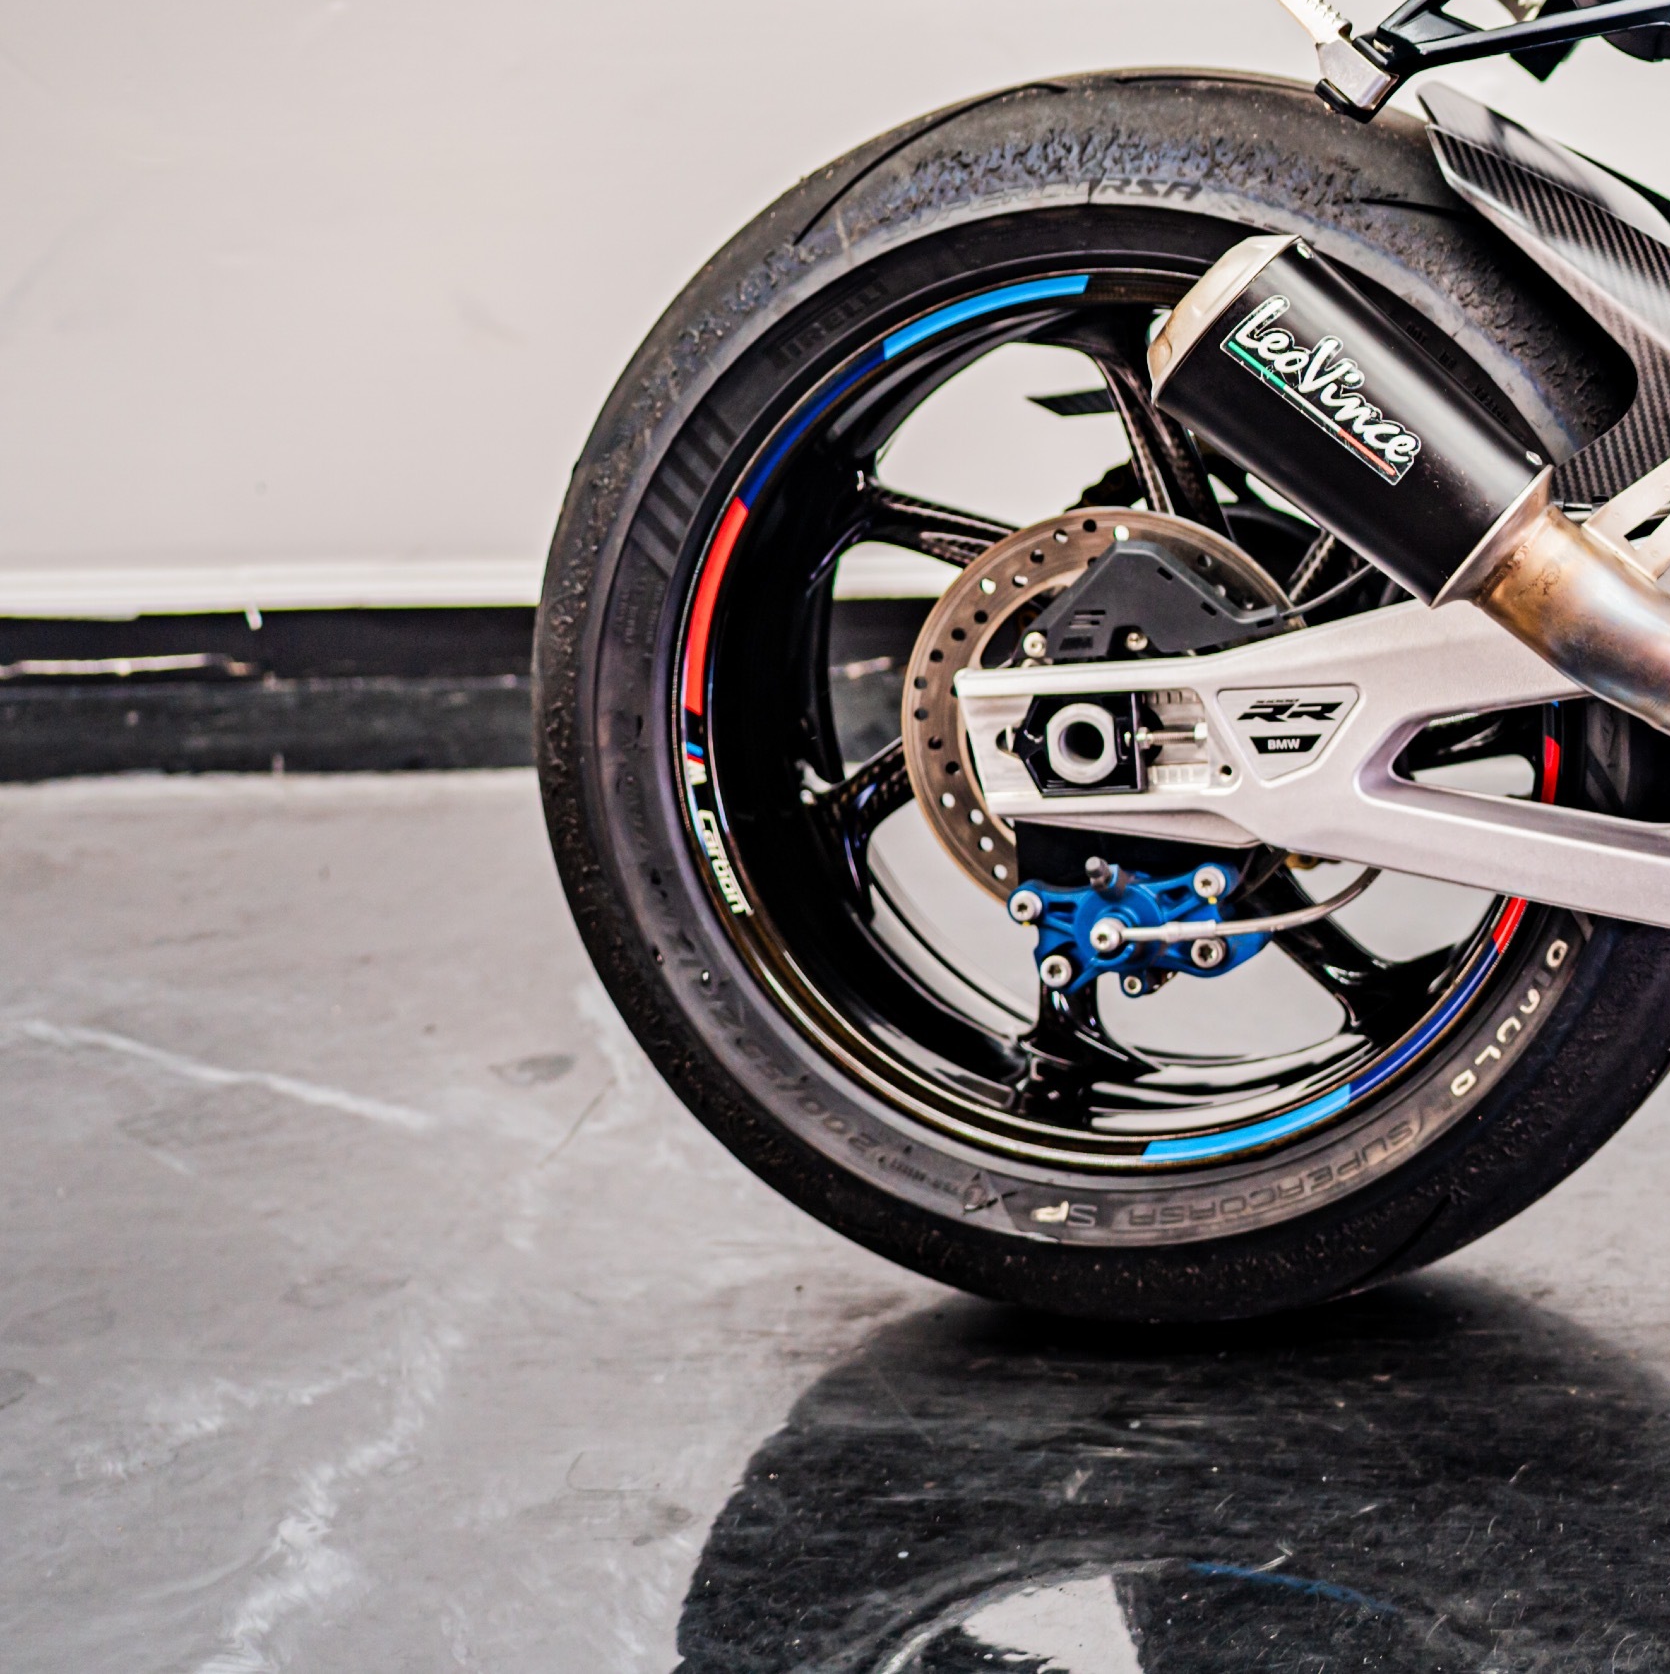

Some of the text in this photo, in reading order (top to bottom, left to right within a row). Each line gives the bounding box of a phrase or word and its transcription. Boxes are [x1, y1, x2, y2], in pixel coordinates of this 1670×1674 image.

[1234, 299, 1417, 462] LeoVince
[1237, 702, 1344, 722] RR
[1267, 739, 1300, 750] BMW
[698, 809, 754, 917] Carbon
[1129, 1121, 1412, 1226] SUPERCORSA
